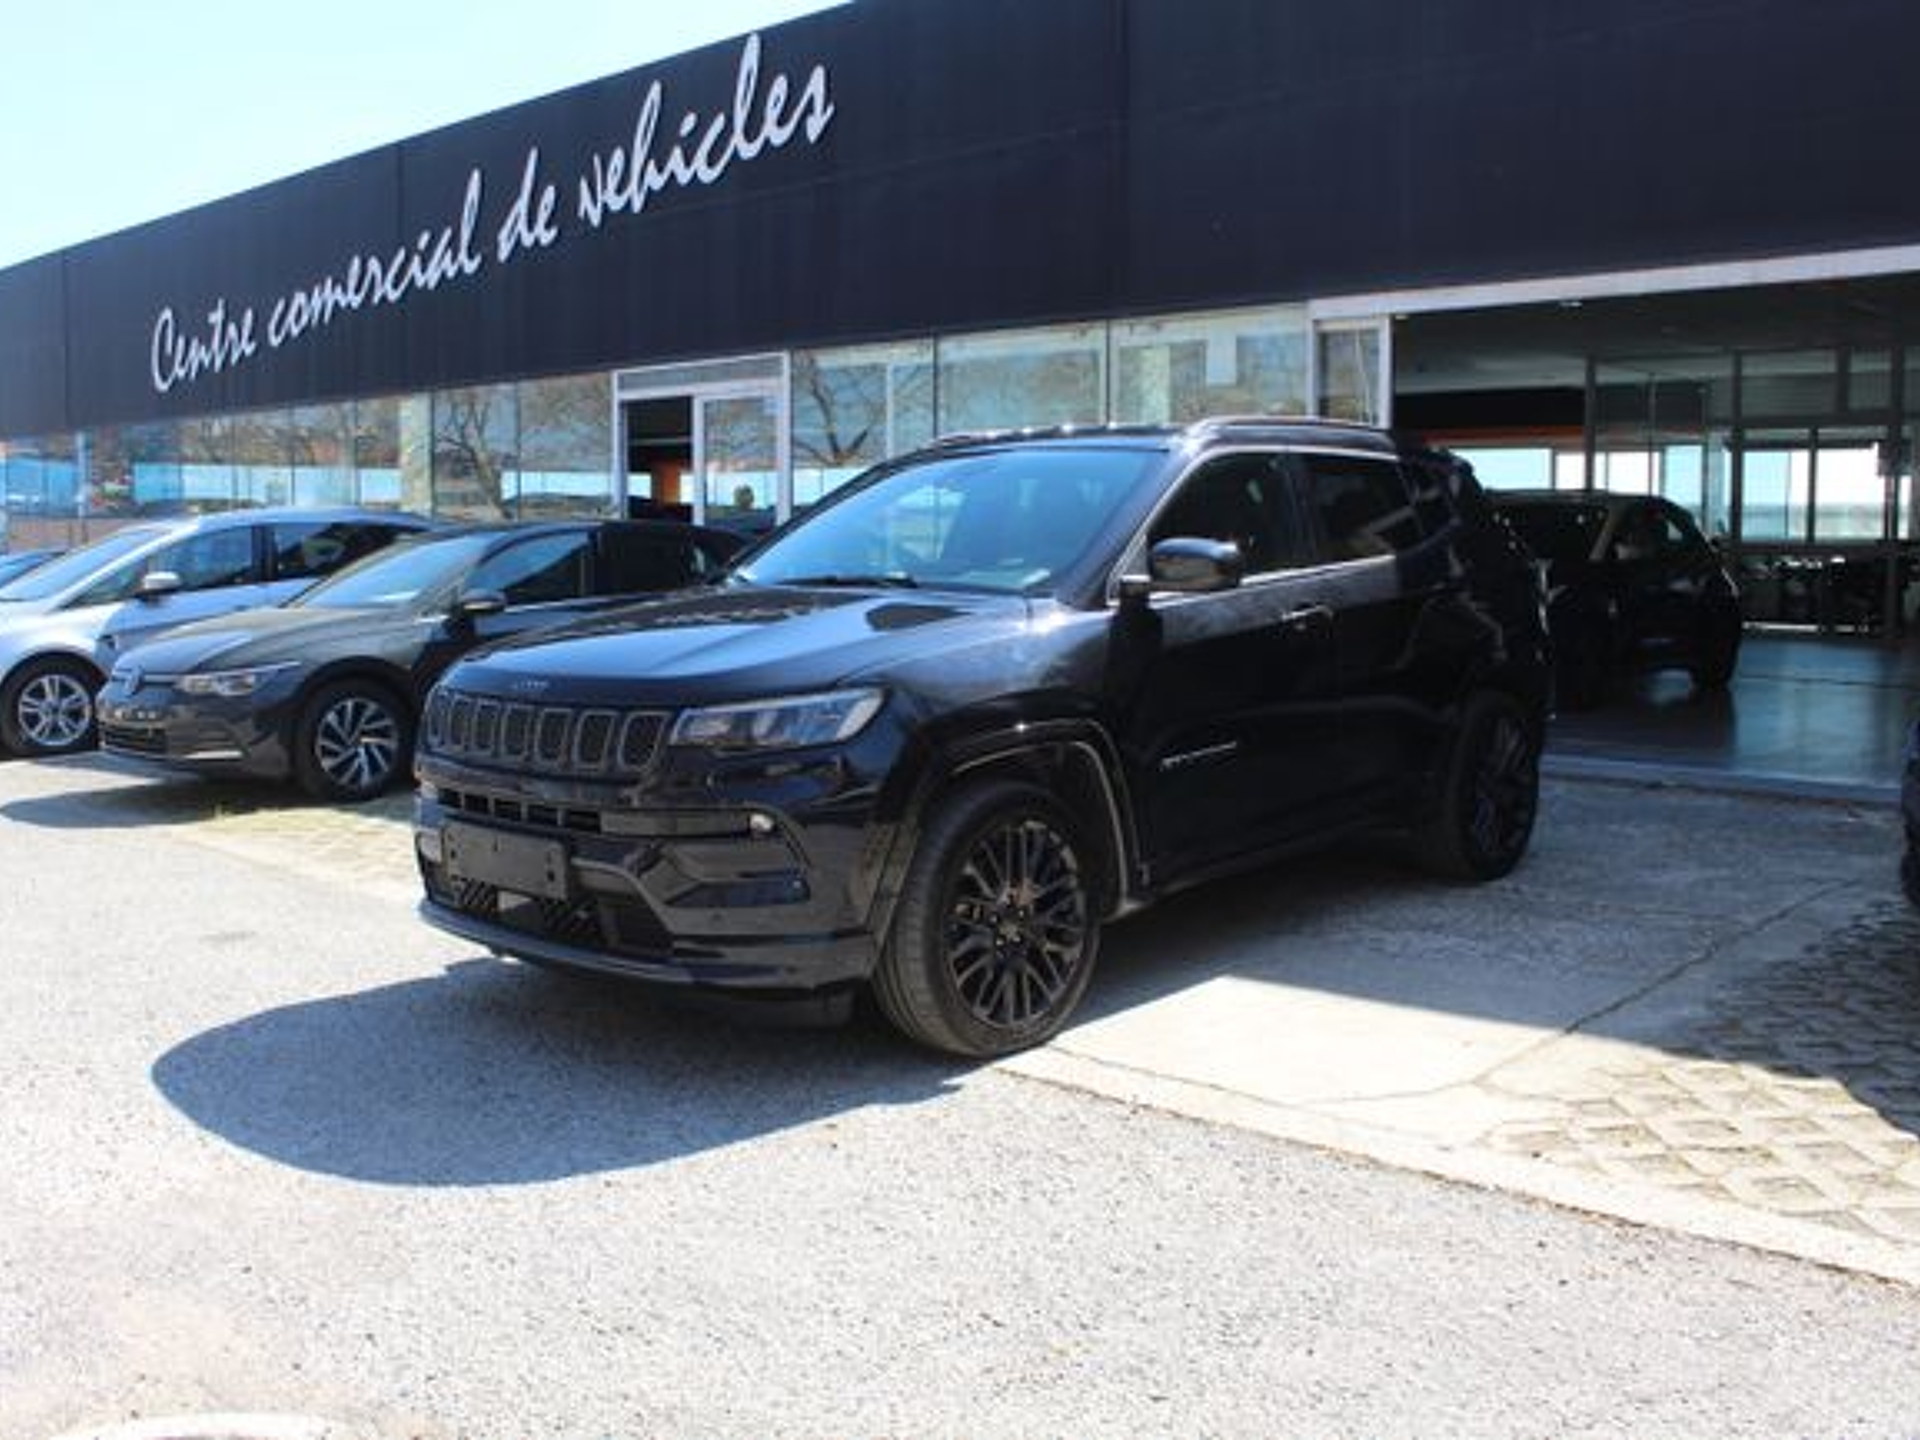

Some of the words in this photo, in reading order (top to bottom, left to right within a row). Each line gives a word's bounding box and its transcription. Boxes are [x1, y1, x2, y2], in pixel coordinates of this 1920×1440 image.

[151, 299, 257, 392] Centre
[267, 168, 482, 348] comercial
[497, 147, 558, 263] de
[579, 32, 835, 226] vehicles
